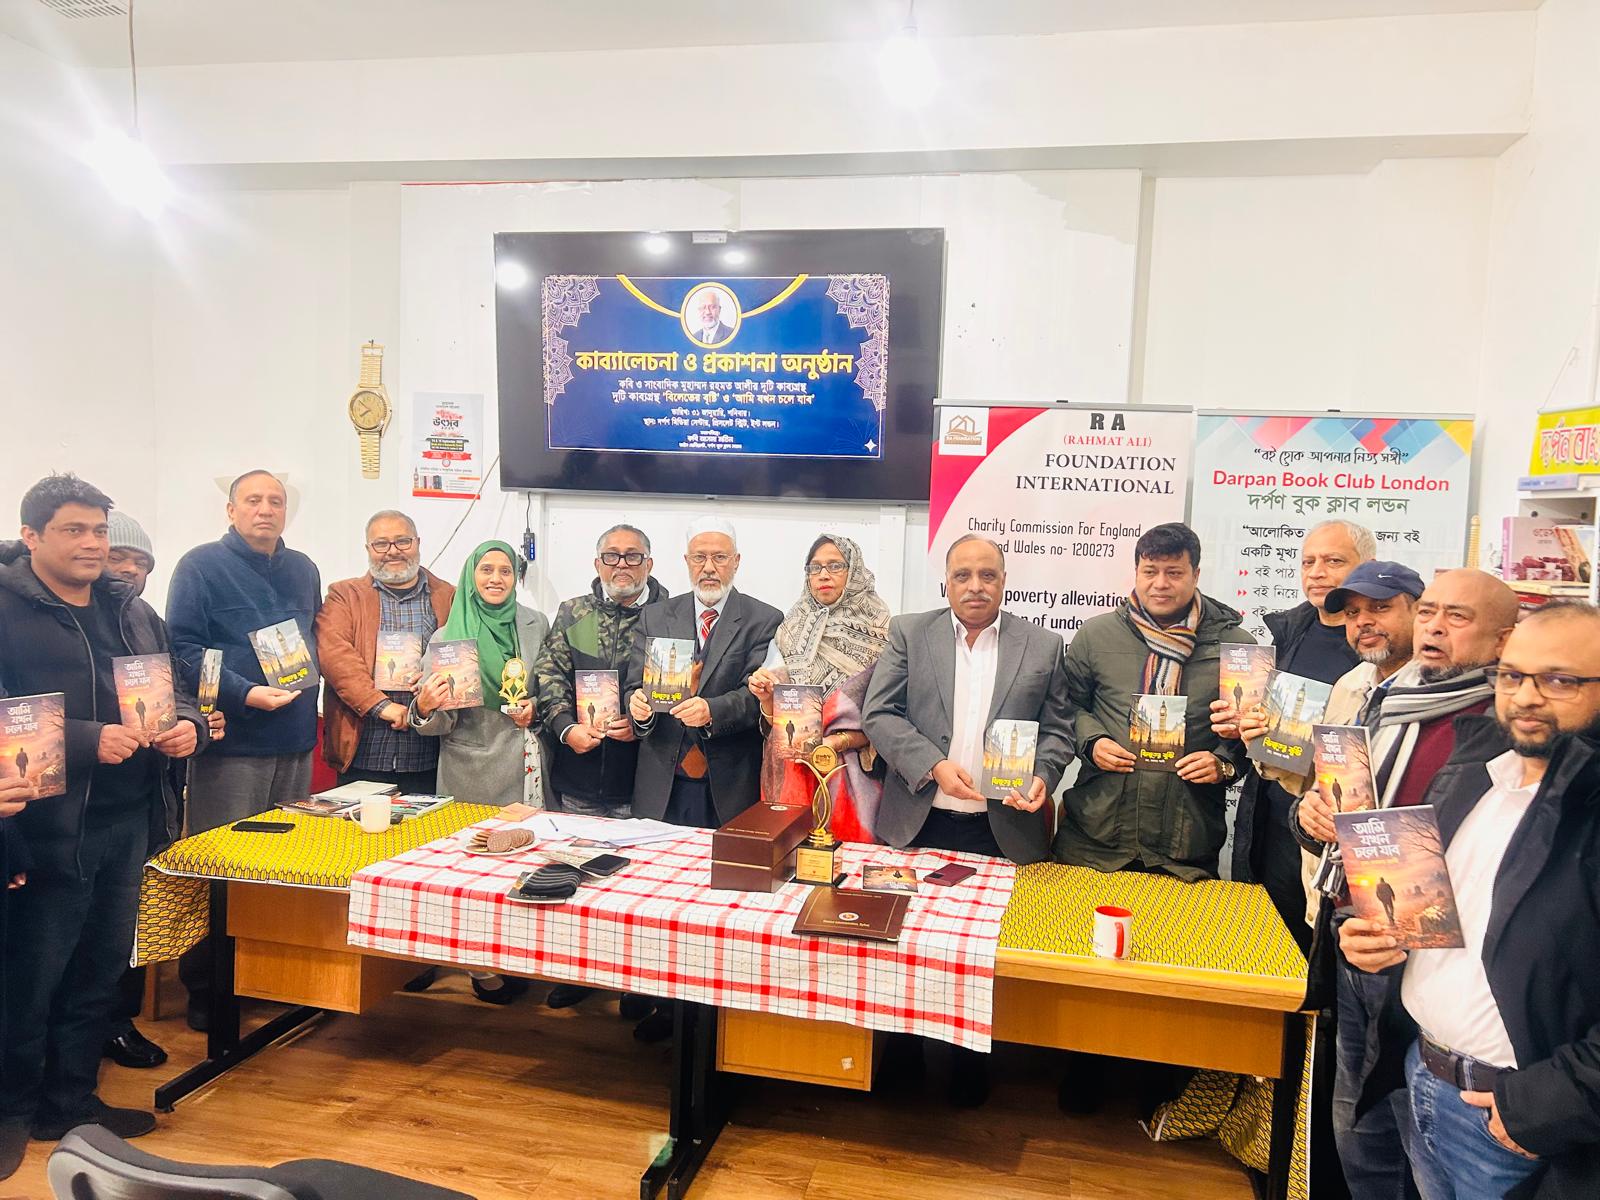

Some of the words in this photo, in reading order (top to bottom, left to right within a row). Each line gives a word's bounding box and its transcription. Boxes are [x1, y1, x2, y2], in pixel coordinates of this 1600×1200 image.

[683, 353, 697, 372] ও
[702, 352, 777, 374] প্রকাশনা
[781, 349, 854, 380] অনুষ্ঠান
[618, 378, 633, 389] কবি
[636, 380, 642, 389] ও
[644, 378, 679, 390] সাংবাদিক
[722, 394, 730, 402] ও
[1090, 412, 1105, 431] R
[1111, 412, 1126, 431] A
[1063, 434, 1123, 447] (RAHMAT
[1127, 436, 1152, 448] ALI)
[1045, 453, 1177, 472] FOUNDATION
[1280, 449, 1304, 466] হোক
[1310, 450, 1351, 463] আপনার
[1353, 447, 1378, 464] নিত্য
[1015, 475, 1174, 495] INTERNATIONAL
[1213, 470, 1277, 489] Darpan
[1282, 472, 1328, 488] Book
[1334, 473, 1375, 489] Club
[1381, 475, 1450, 491] London
[1247, 489, 1287, 510] দর্পণ
[1291, 495, 1321, 516] বুক
[1327, 496, 1361, 514] ক্লাব
[1366, 497, 1410, 514] লন্ডন
[968, 517, 1006, 536] Charity
[1010, 519, 1074, 536] Commission
[1078, 521, 1095, 536] For
[1100, 522, 1142, 542] England
[1375, 529, 1400, 542] জন্য
[1404, 529, 1421, 543] বই
[996, 540, 1009, 553] nd
[1014, 540, 1046, 554] Wales
[1050, 545, 1068, 555] no-
[1072, 543, 1115, 558] 1200273
[1240, 543, 1273, 558] একটি
[1255, 565, 1271, 579] বই
[1274, 566, 1296, 579] পাঠ
[1004, 589, 1056, 609] poverty
[1061, 590, 1129, 608] alleviatio
[1253, 585, 1269, 599] বই
[1274, 585, 1299, 599] নিয়ে
[1252, 606, 1268, 618] বই
[1033, 614, 1047, 627] of
[1050, 616, 1083, 630] unde
[1250, 625, 1266, 638] বই
[1351, 817, 1385, 835] আমি
[1358, 833, 1391, 847] যখন
[1352, 846, 1378, 859] চলে
[1379, 845, 1401, 857] যাব
